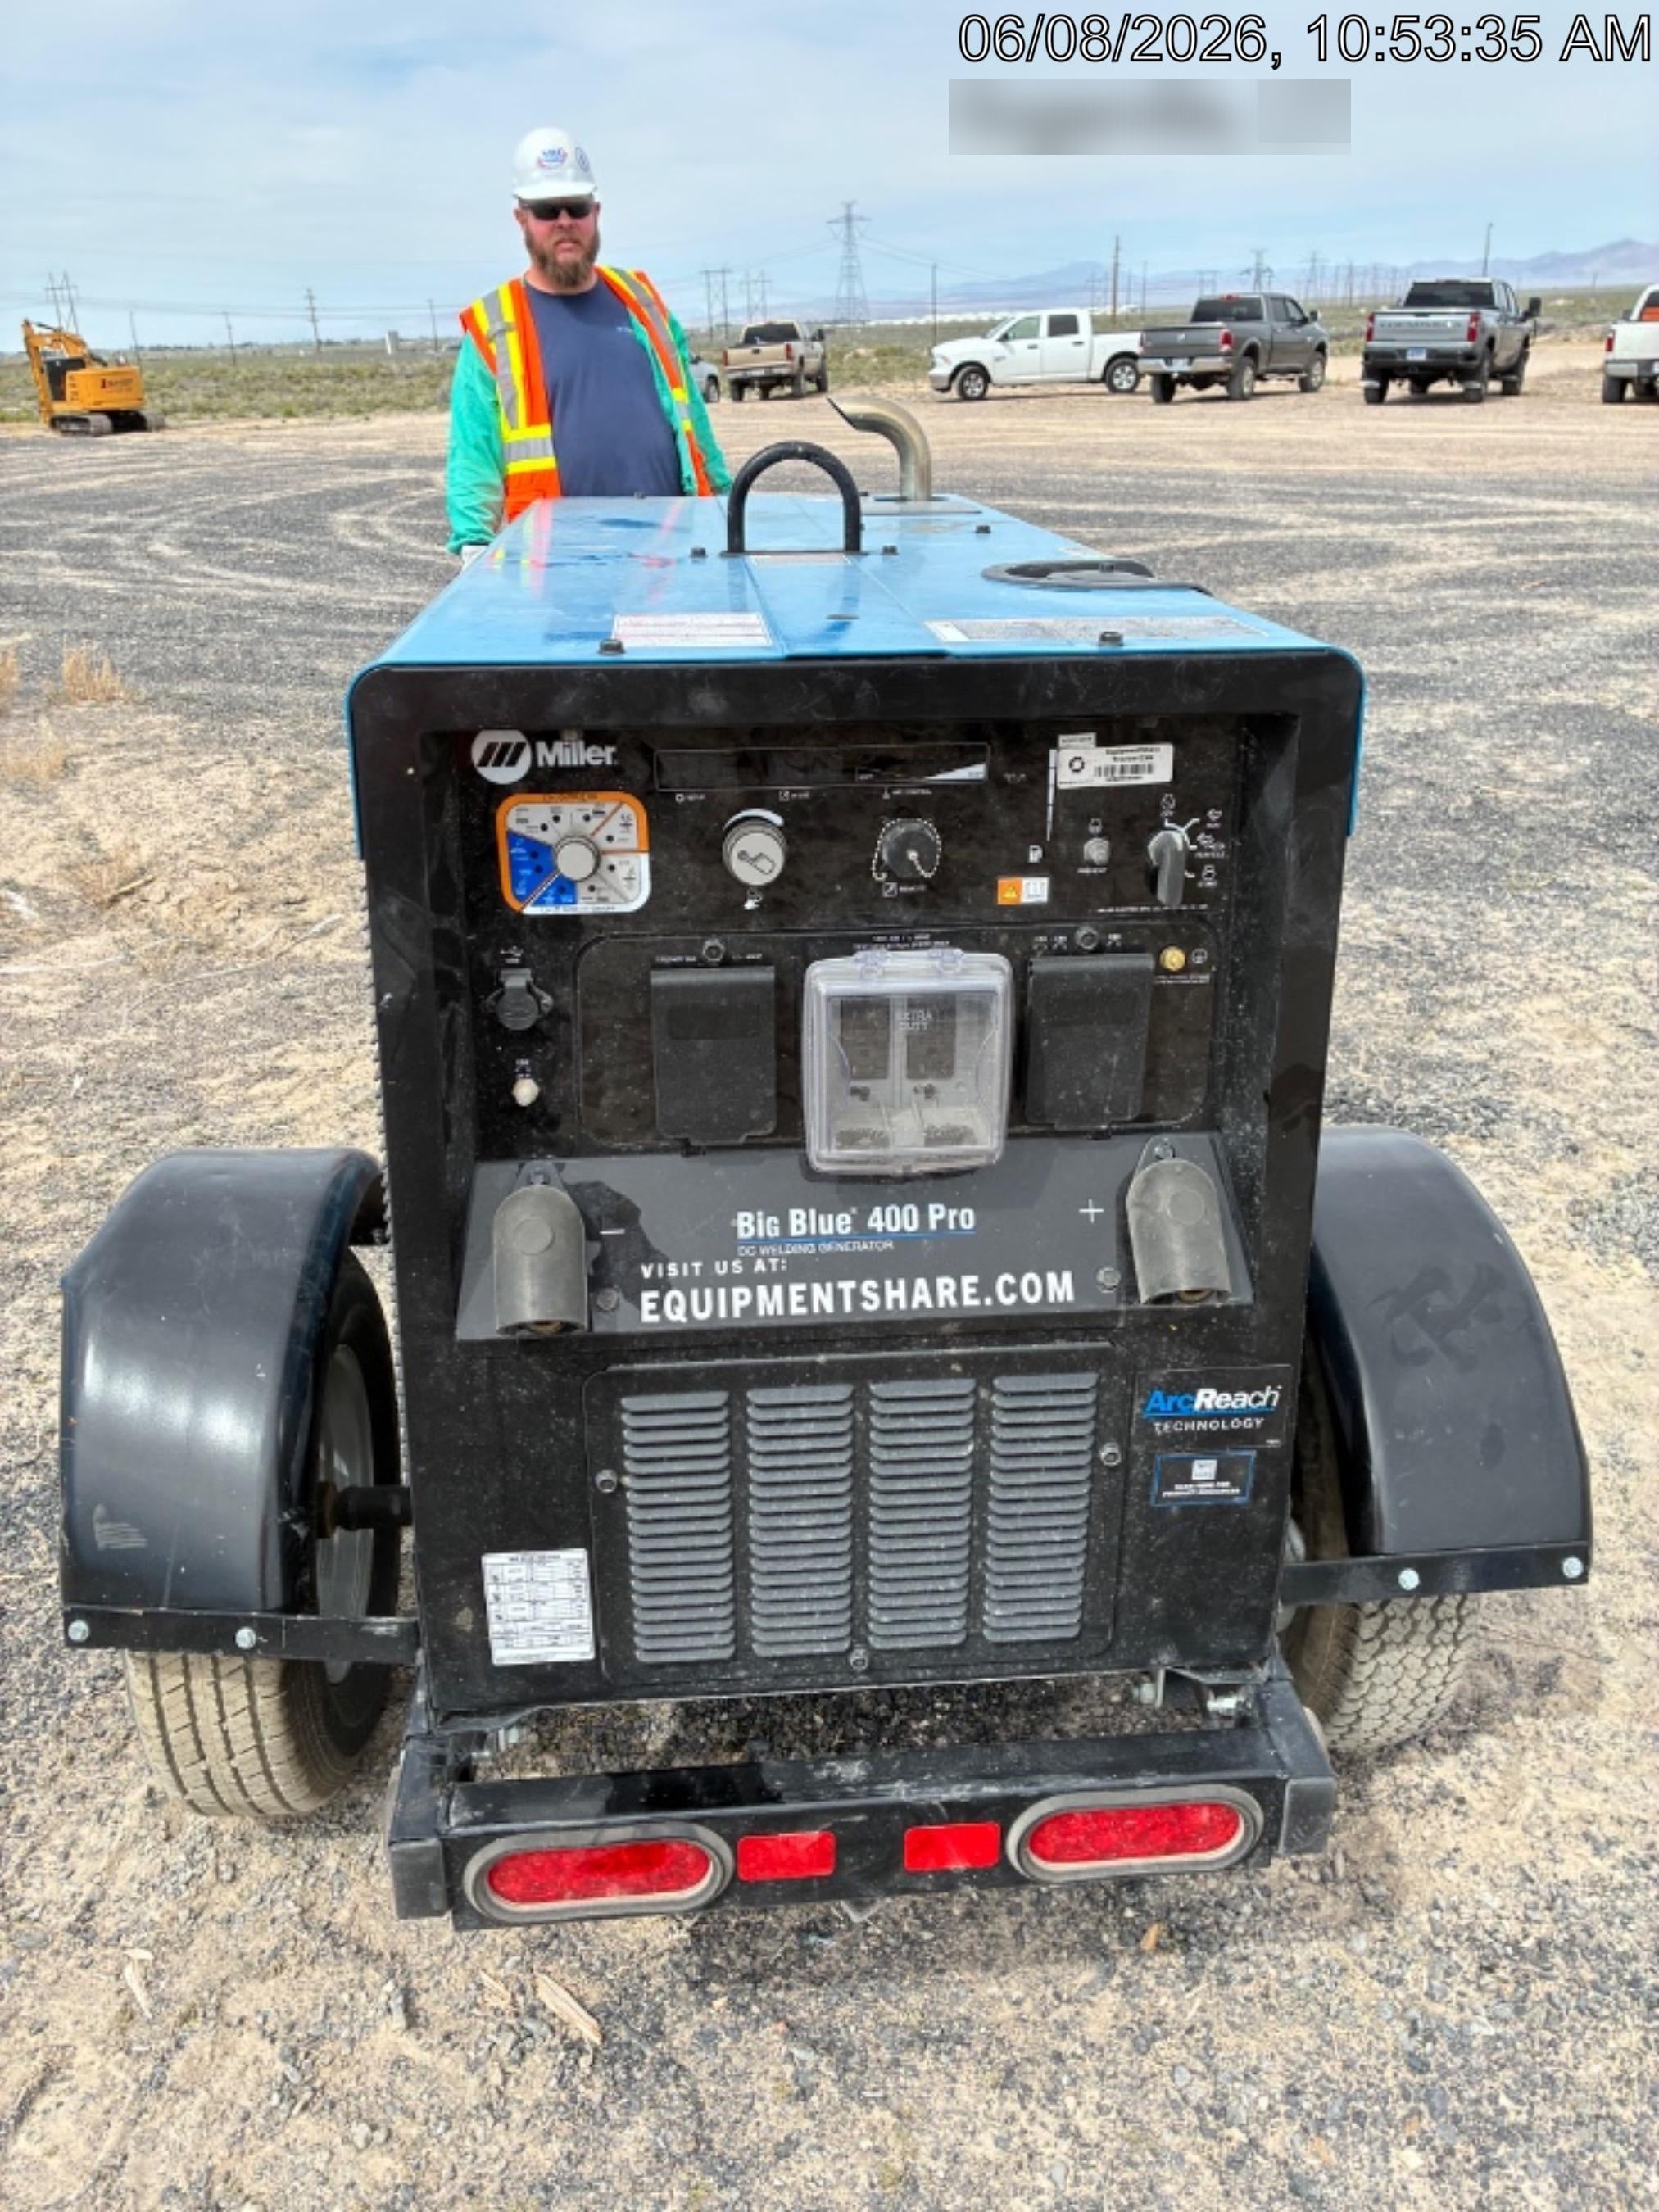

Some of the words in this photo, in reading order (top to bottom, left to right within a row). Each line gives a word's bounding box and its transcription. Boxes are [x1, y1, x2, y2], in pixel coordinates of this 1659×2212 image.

[535, 740, 617, 767] Miller
[867, 1203, 918, 1233] 400
[927, 1203, 975, 1231] Pro
[759, 1242, 817, 1257] WELDING
[640, 1262, 703, 1279] VISIT
[714, 1259, 743, 1276] US
[754, 1257, 787, 1273] AT:
[640, 1270, 1075, 1323] EQUIPMENTSHARE.COM
[1146, 1385, 1280, 1412] ArcReach
[1154, 1417, 1264, 1434] TECHNOLOGY
